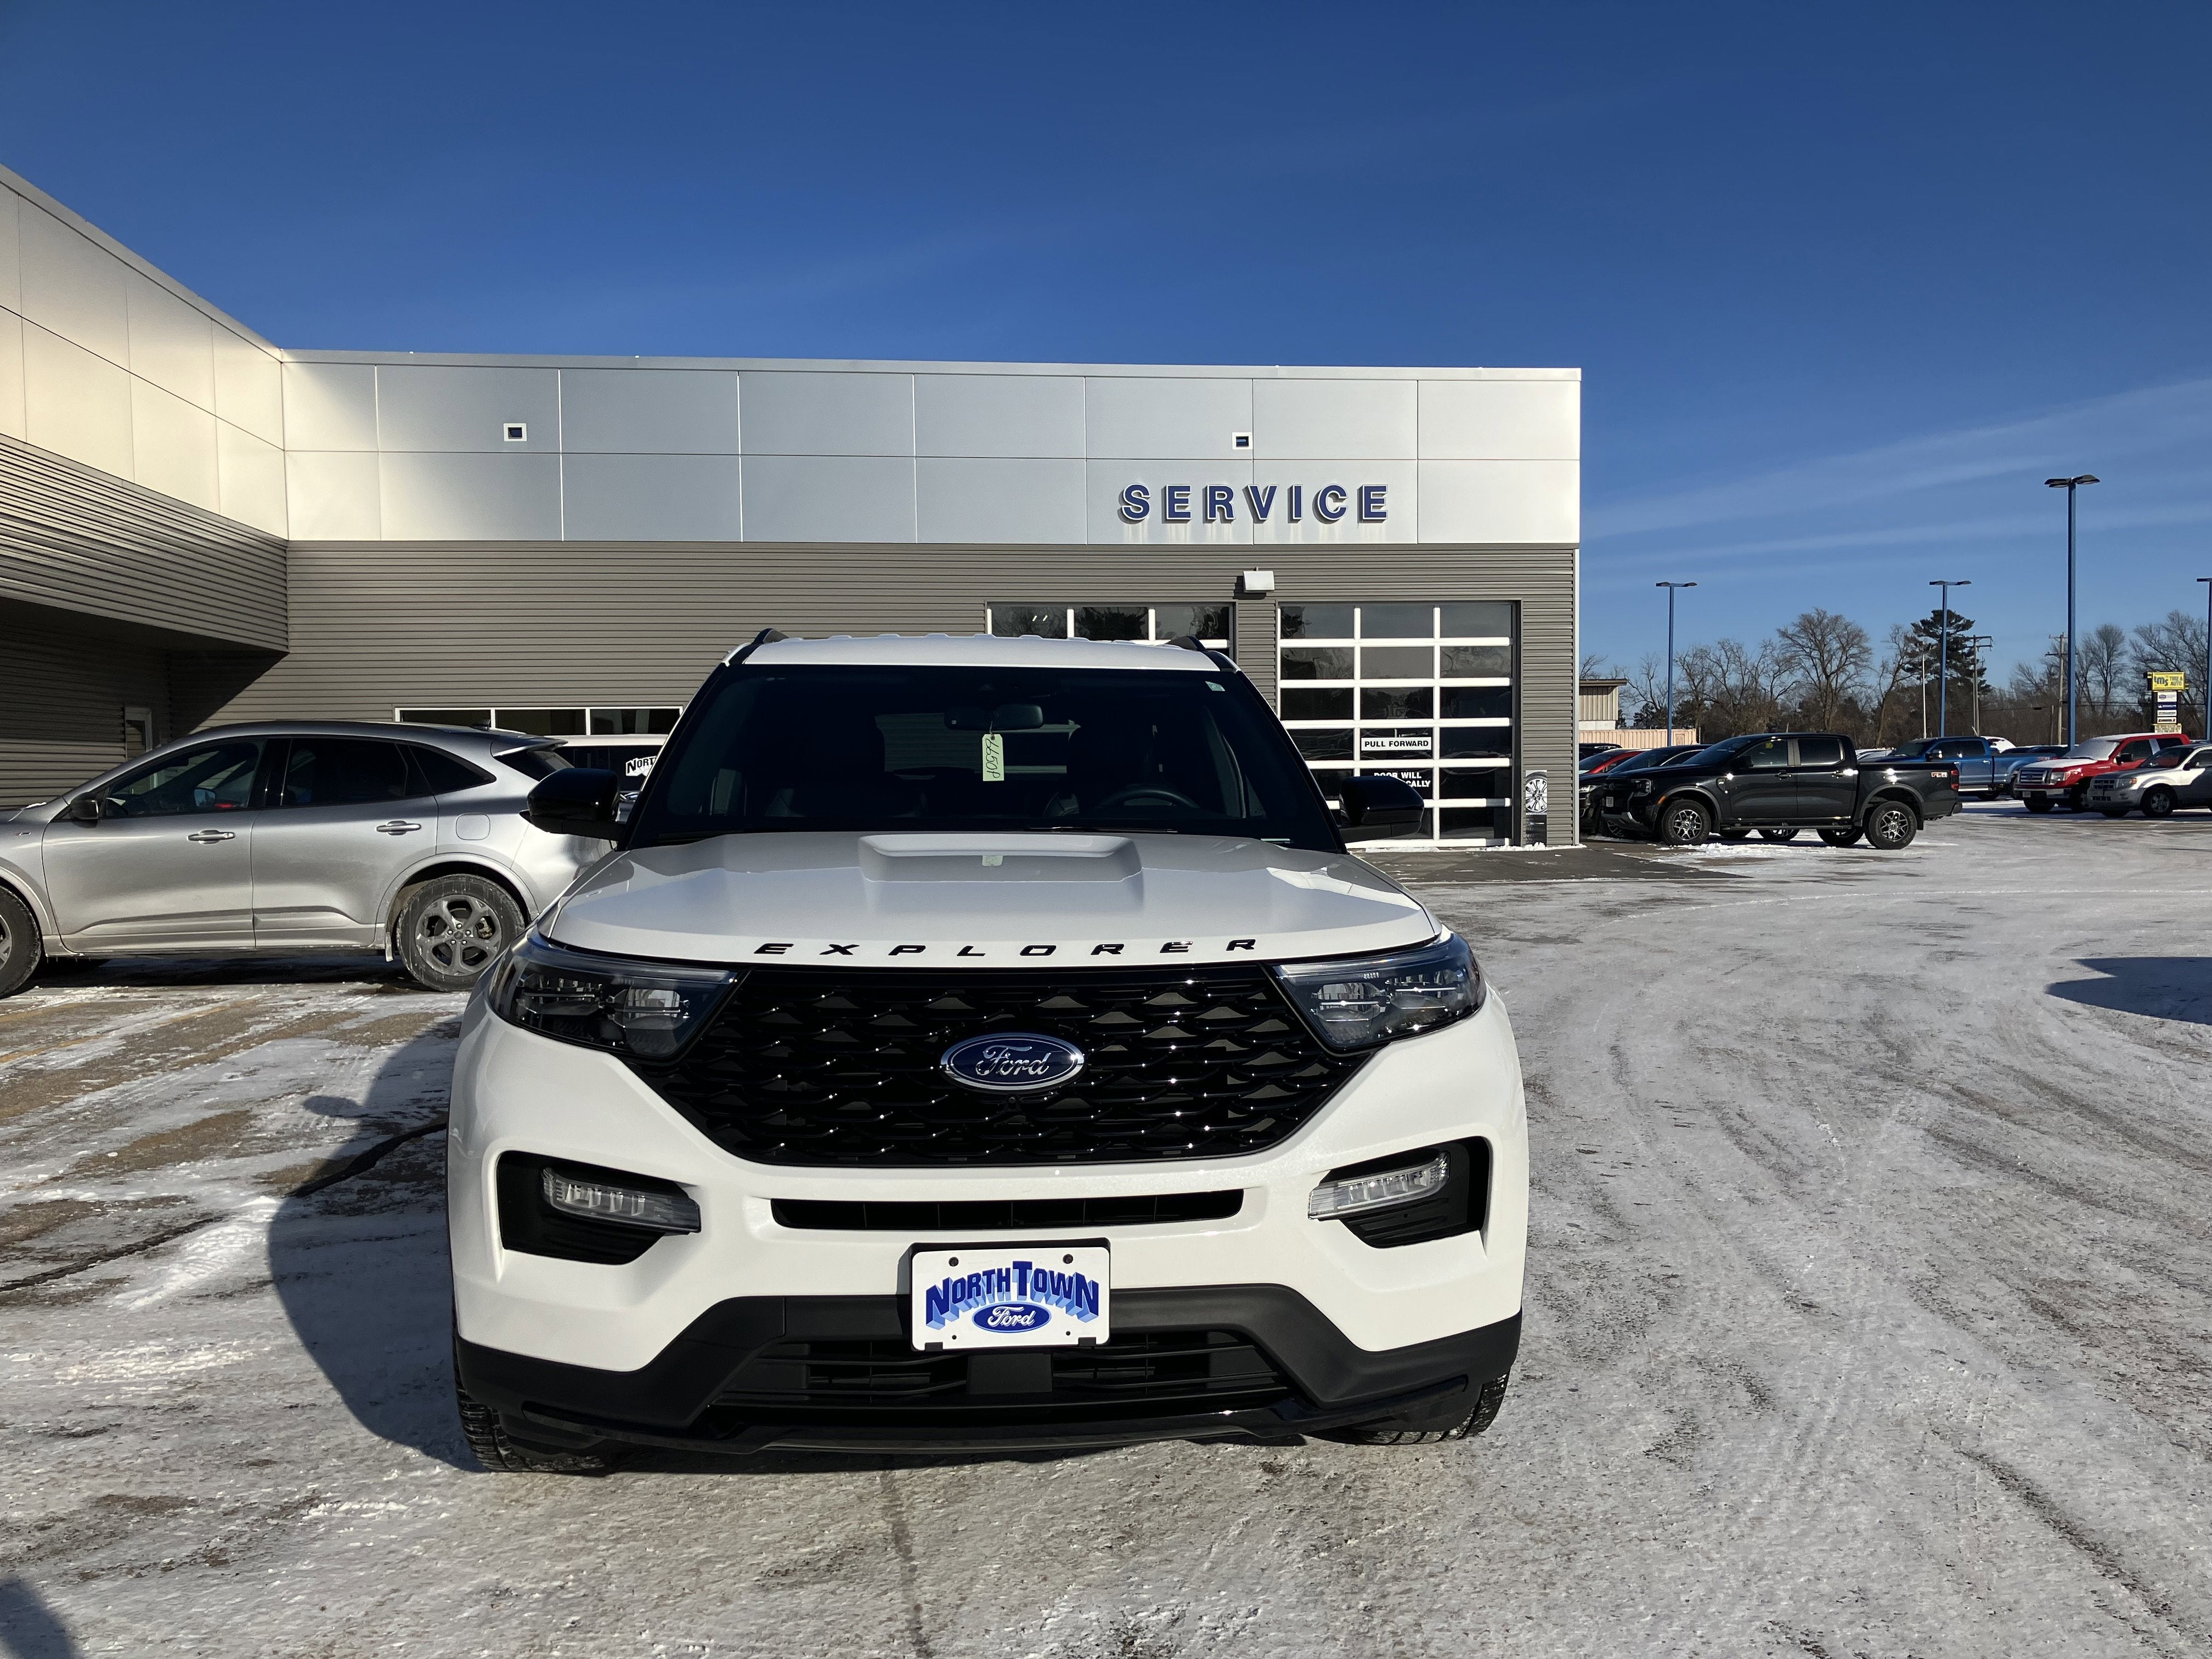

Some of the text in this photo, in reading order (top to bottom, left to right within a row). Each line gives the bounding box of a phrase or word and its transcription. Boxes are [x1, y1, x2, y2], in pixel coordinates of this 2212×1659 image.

[1119, 483, 1389, 522] SERVICE
[627, 757, 657, 774] NORT
[985, 738, 1001, 778] 6650P
[753, 939, 1256, 957] EXPLORER
[975, 1045, 1051, 1076] Ford
[987, 1306, 1036, 1327] Ford
